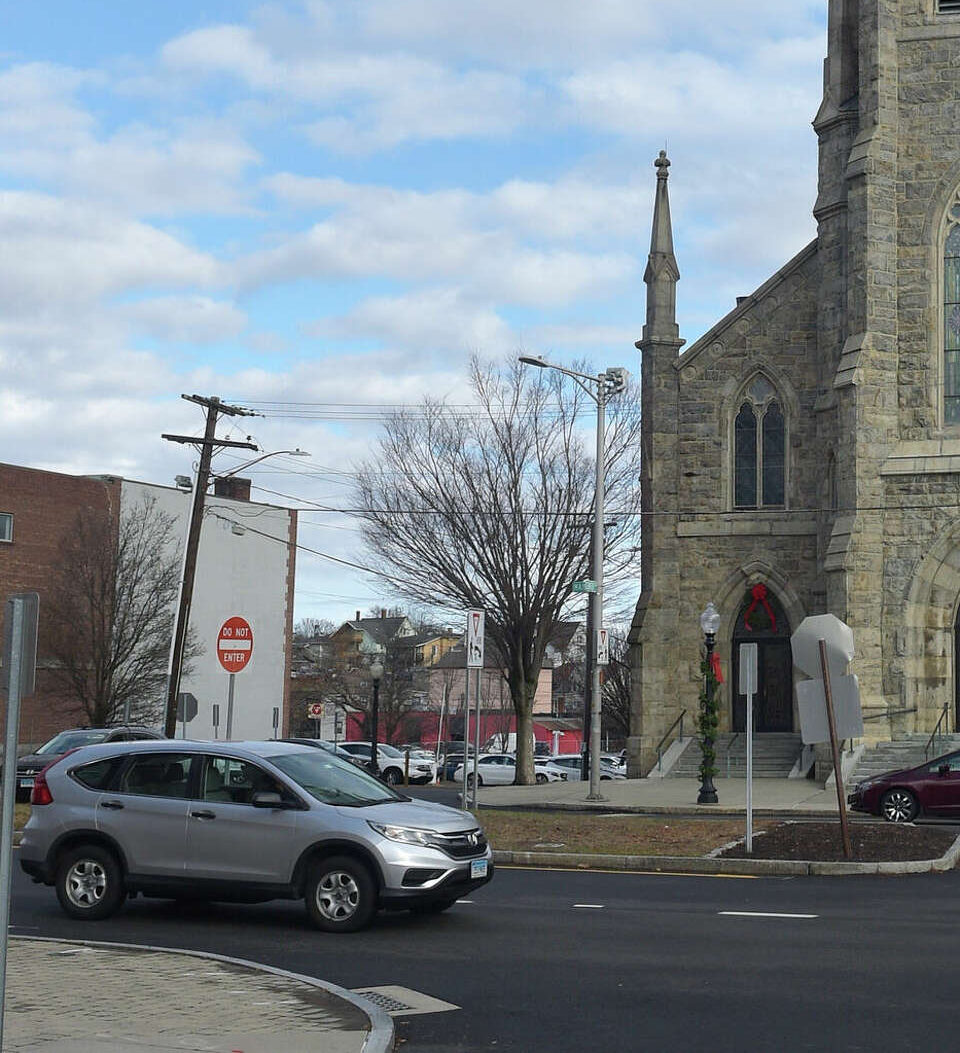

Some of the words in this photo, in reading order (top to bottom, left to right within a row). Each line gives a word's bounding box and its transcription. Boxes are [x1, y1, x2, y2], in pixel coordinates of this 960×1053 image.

[222, 627, 233, 637] DO
[235, 627, 249, 637] NOT
[223, 652, 245, 663] ENTER
